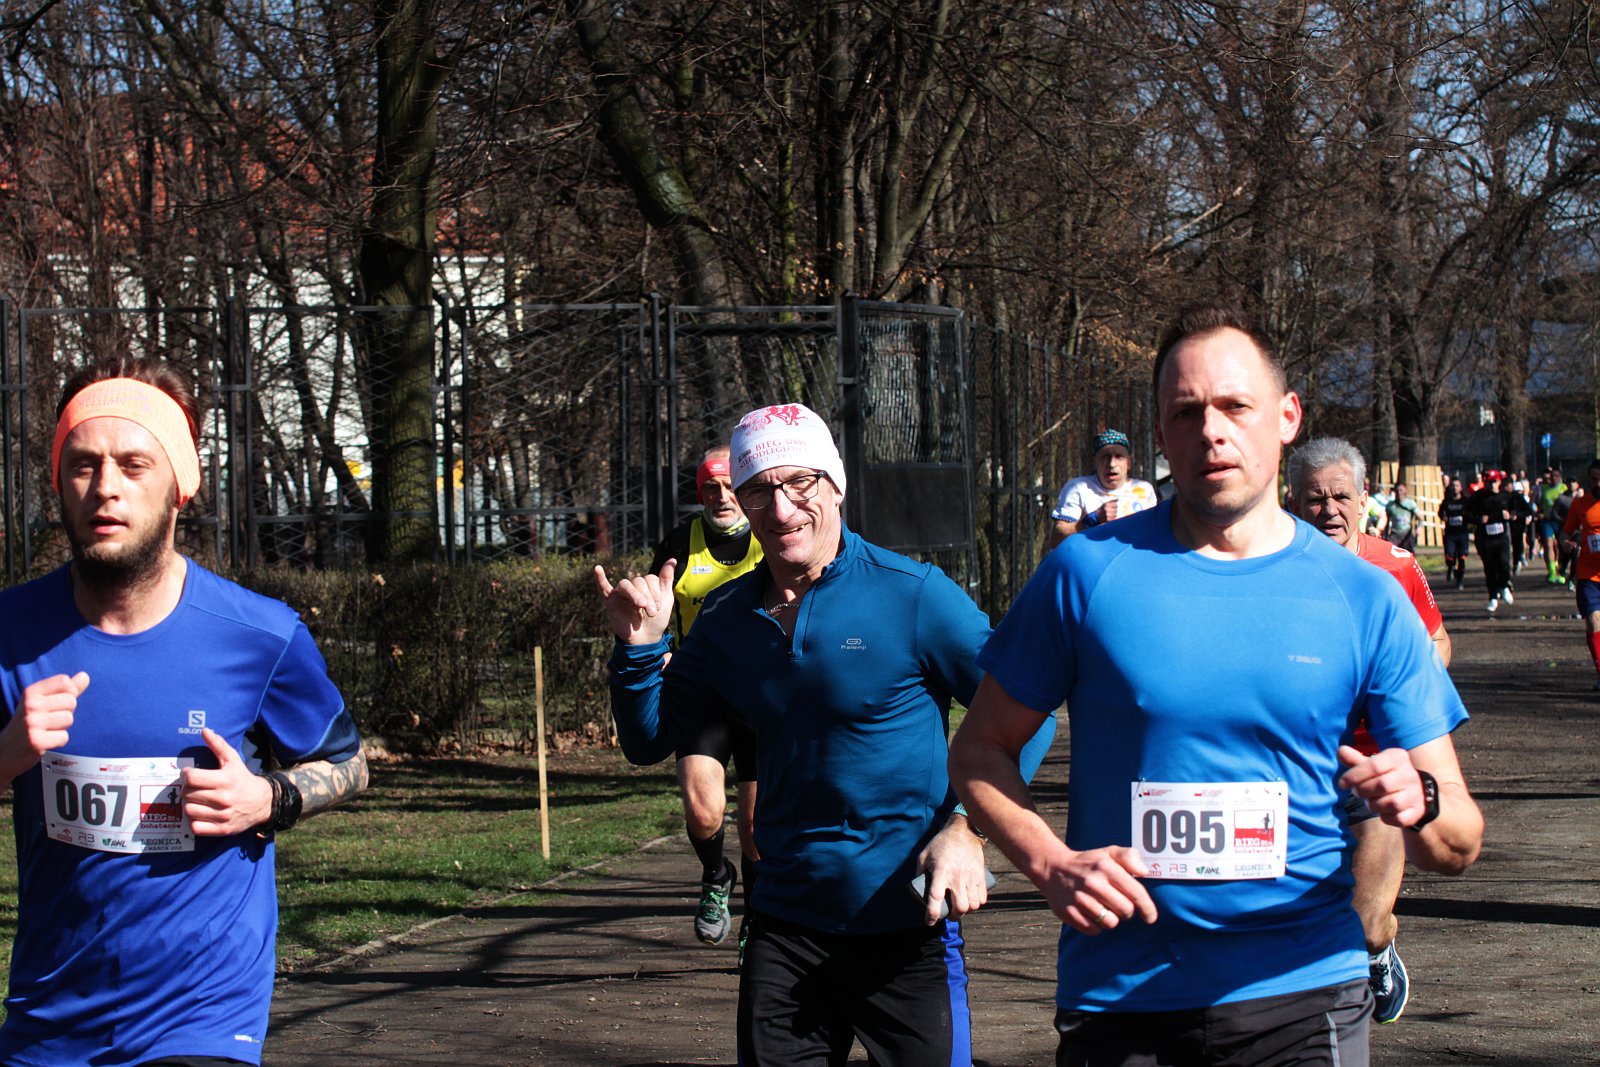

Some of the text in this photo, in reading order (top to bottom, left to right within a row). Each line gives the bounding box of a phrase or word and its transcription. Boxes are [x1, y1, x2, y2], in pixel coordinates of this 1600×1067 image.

[755, 439, 782, 452] BIEG
[56, 778, 128, 827] 067
[1142, 809, 1226, 854] 095
[141, 838, 182, 846] LEGNICA
[1234, 863, 1273, 872] LEGNICA
